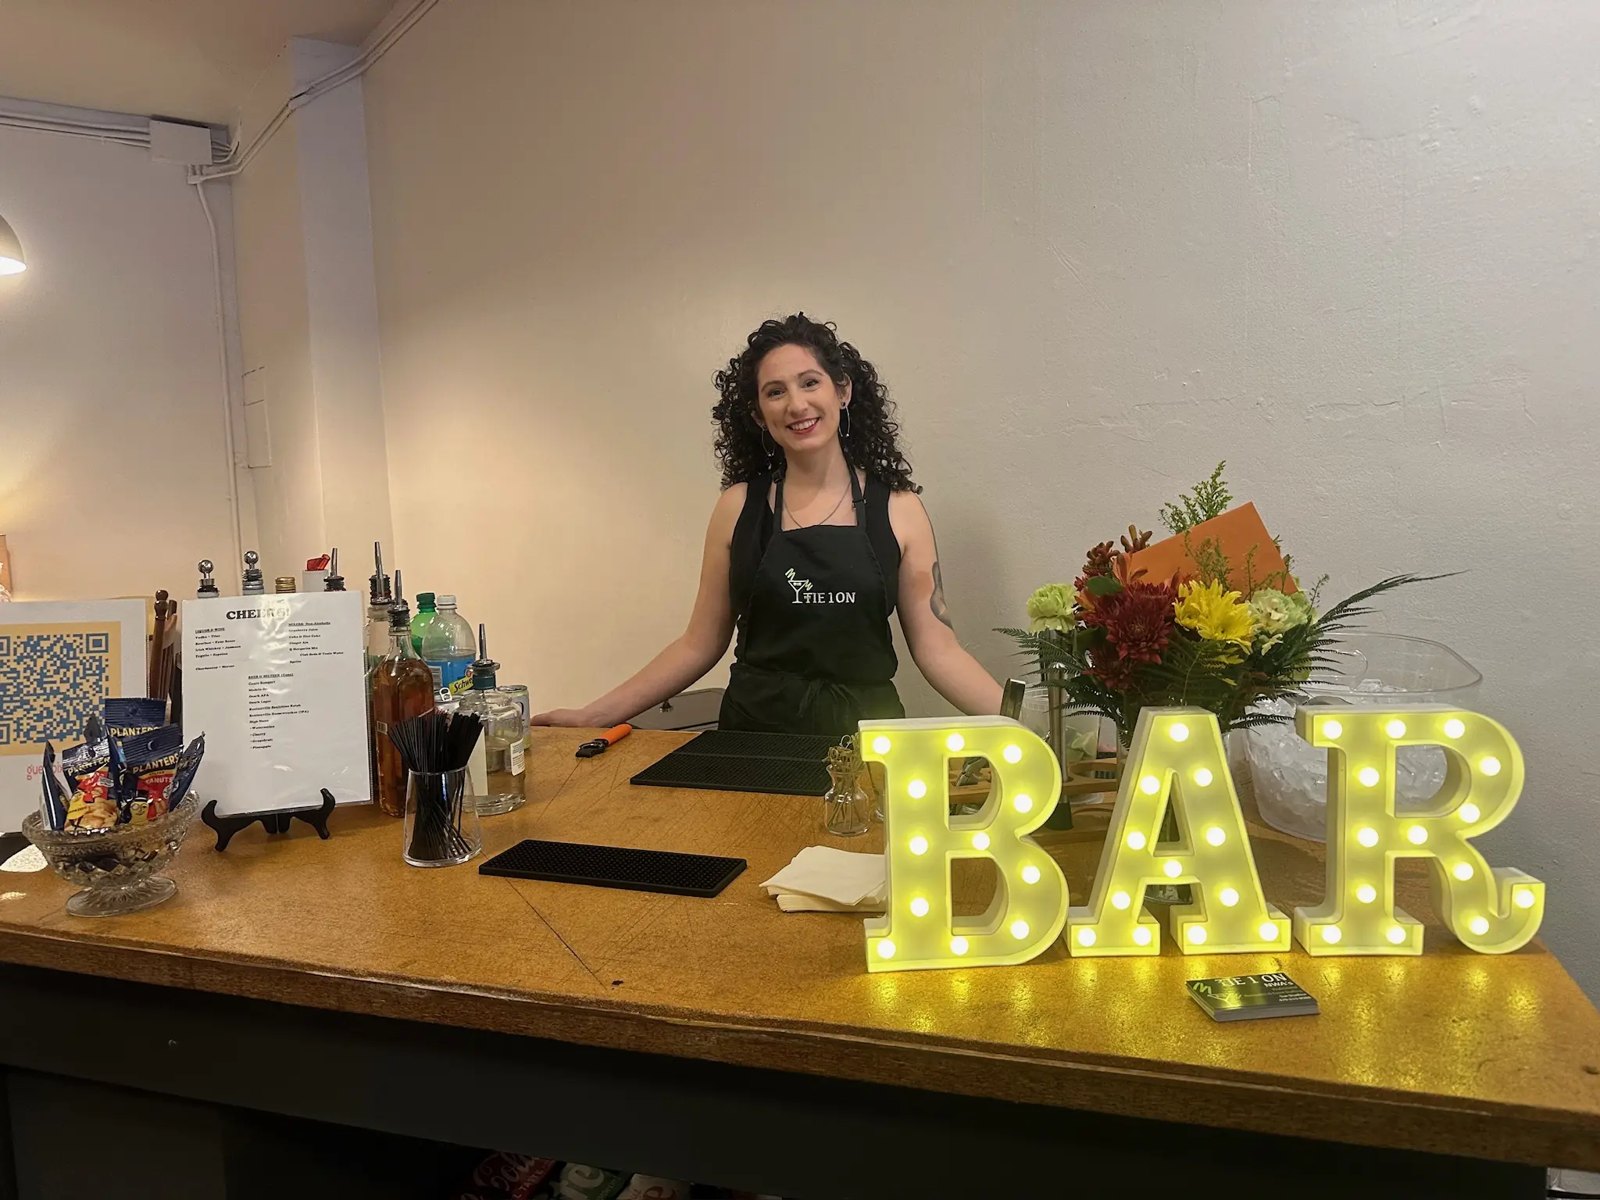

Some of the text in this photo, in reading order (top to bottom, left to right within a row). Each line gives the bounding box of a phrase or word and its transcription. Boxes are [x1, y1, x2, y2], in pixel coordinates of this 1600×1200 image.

[110, 726, 161, 737] PLANTE
[132, 753, 179, 774] PLANTERS
[858, 705, 1546, 973] BAR
[1215, 977, 1246, 987] TIE
[1261, 973, 1288, 983] ON
